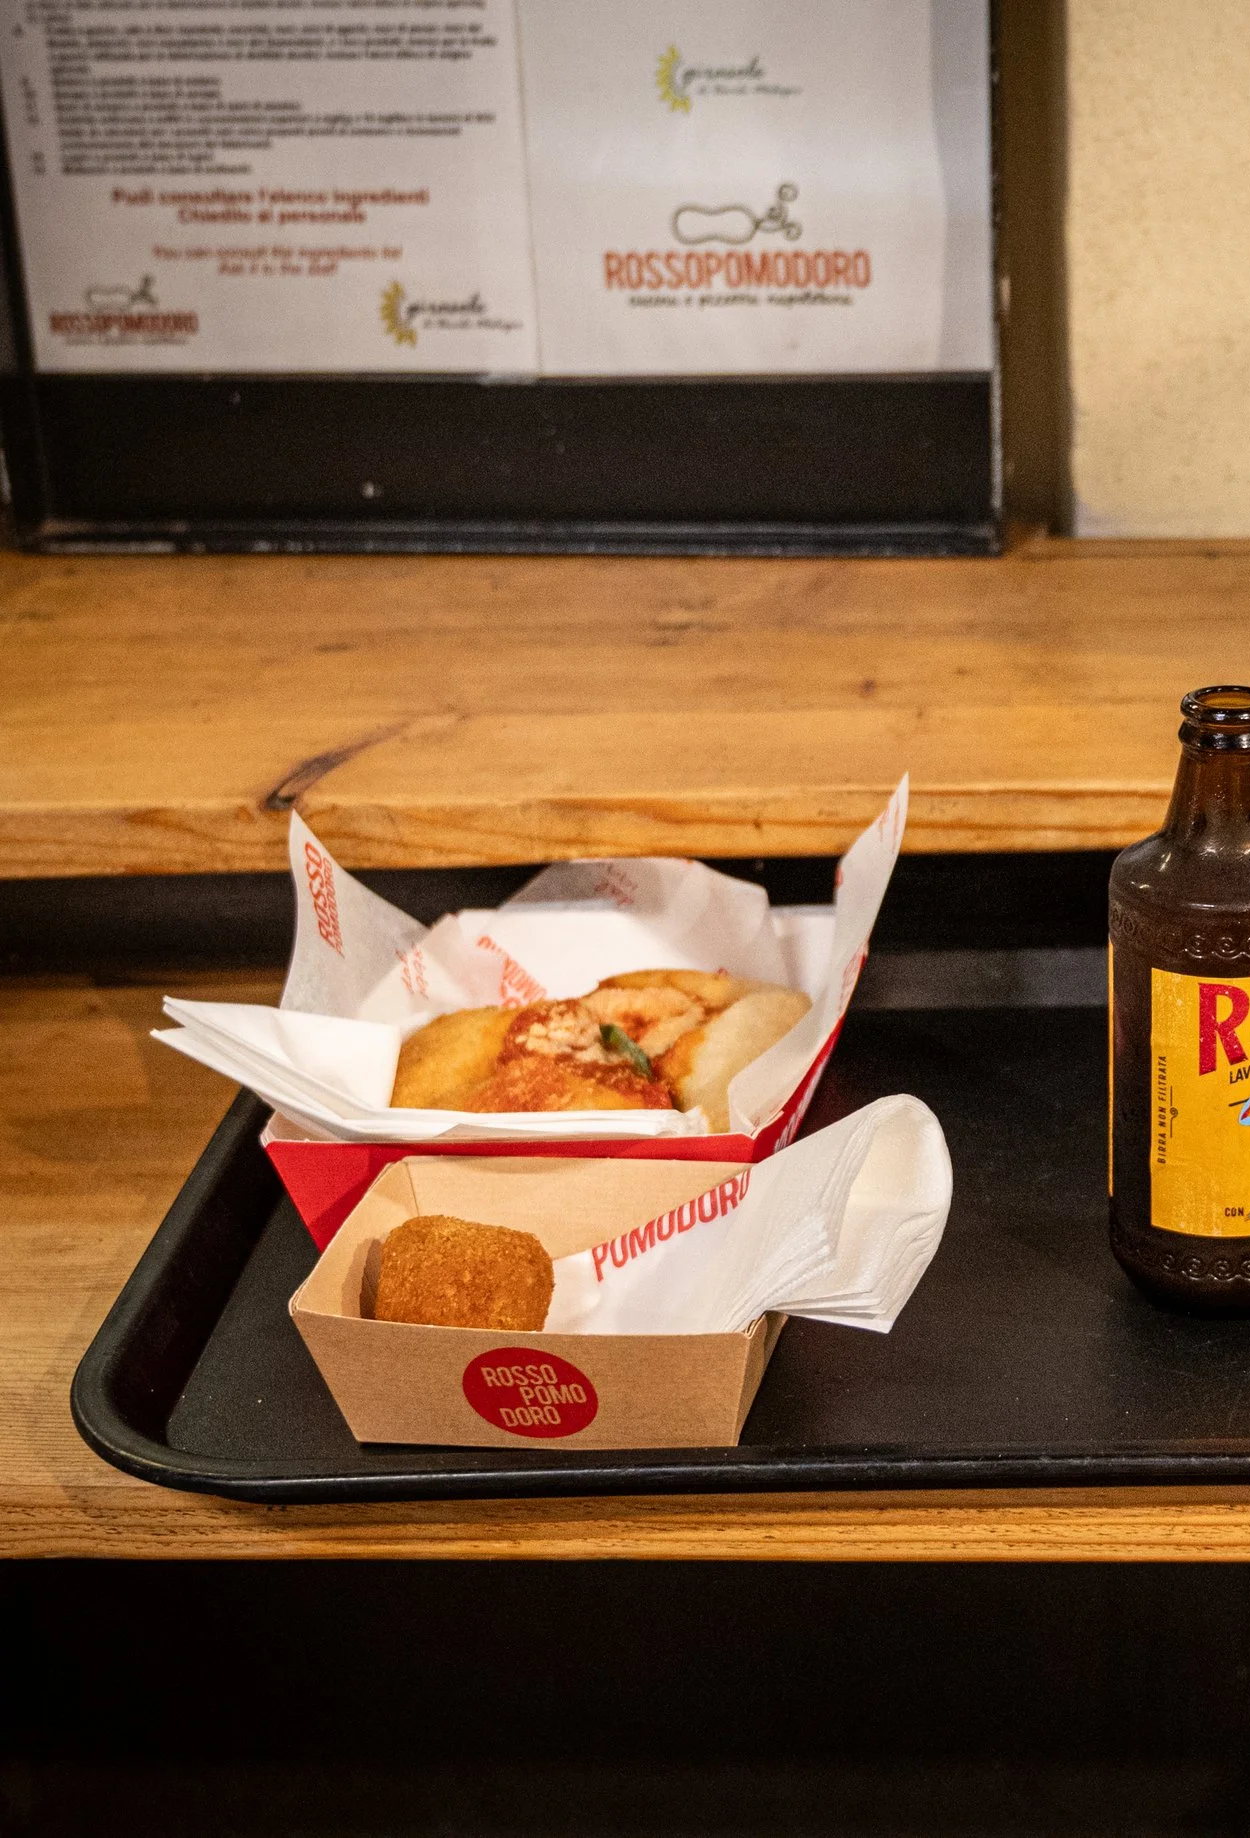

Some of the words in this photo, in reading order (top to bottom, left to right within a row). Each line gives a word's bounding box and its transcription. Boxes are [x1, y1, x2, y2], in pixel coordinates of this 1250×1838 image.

[603, 249, 871, 290] ROSSOPOMODORO
[1158, 1056, 1167, 1101] FILTRATA
[1158, 1106, 1166, 1127] NON
[1157, 1133, 1166, 1165] BIRRA
[1224, 1206, 1245, 1217] CON
[591, 1166, 752, 1283] POMODORO
[480, 1363, 559, 1388] ROSSO
[519, 1383, 587, 1406] POMO
[499, 1405, 562, 1428] DORO
